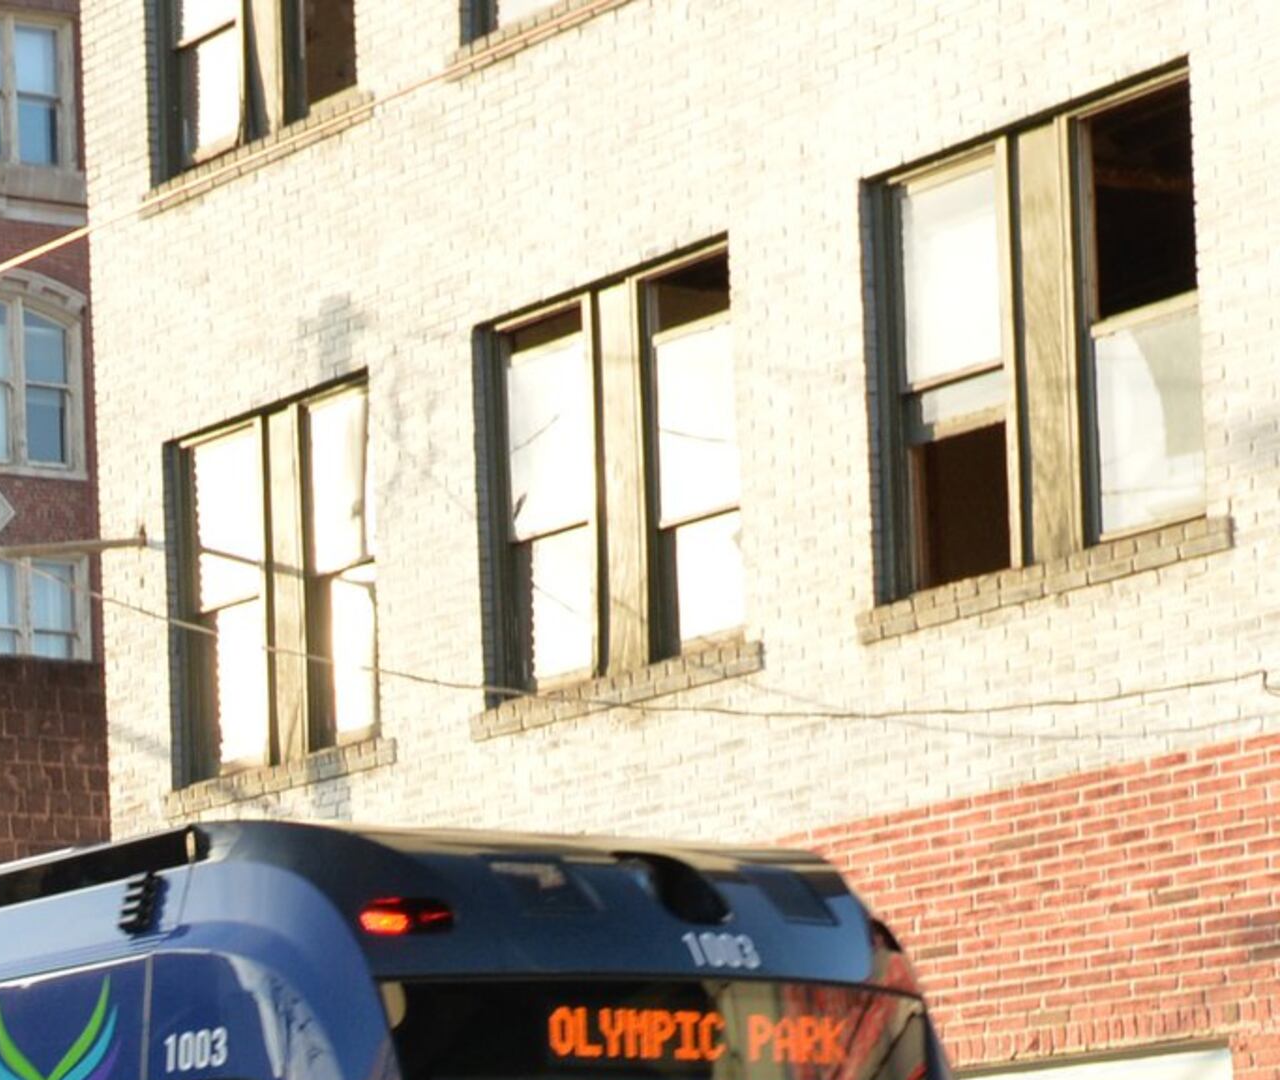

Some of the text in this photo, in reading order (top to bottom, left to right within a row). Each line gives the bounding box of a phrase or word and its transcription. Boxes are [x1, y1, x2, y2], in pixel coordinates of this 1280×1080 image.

[681, 931, 762, 969] 1003
[163, 1026, 228, 1074] 1003
[548, 1006, 847, 1064] OLYMPIC PARK
